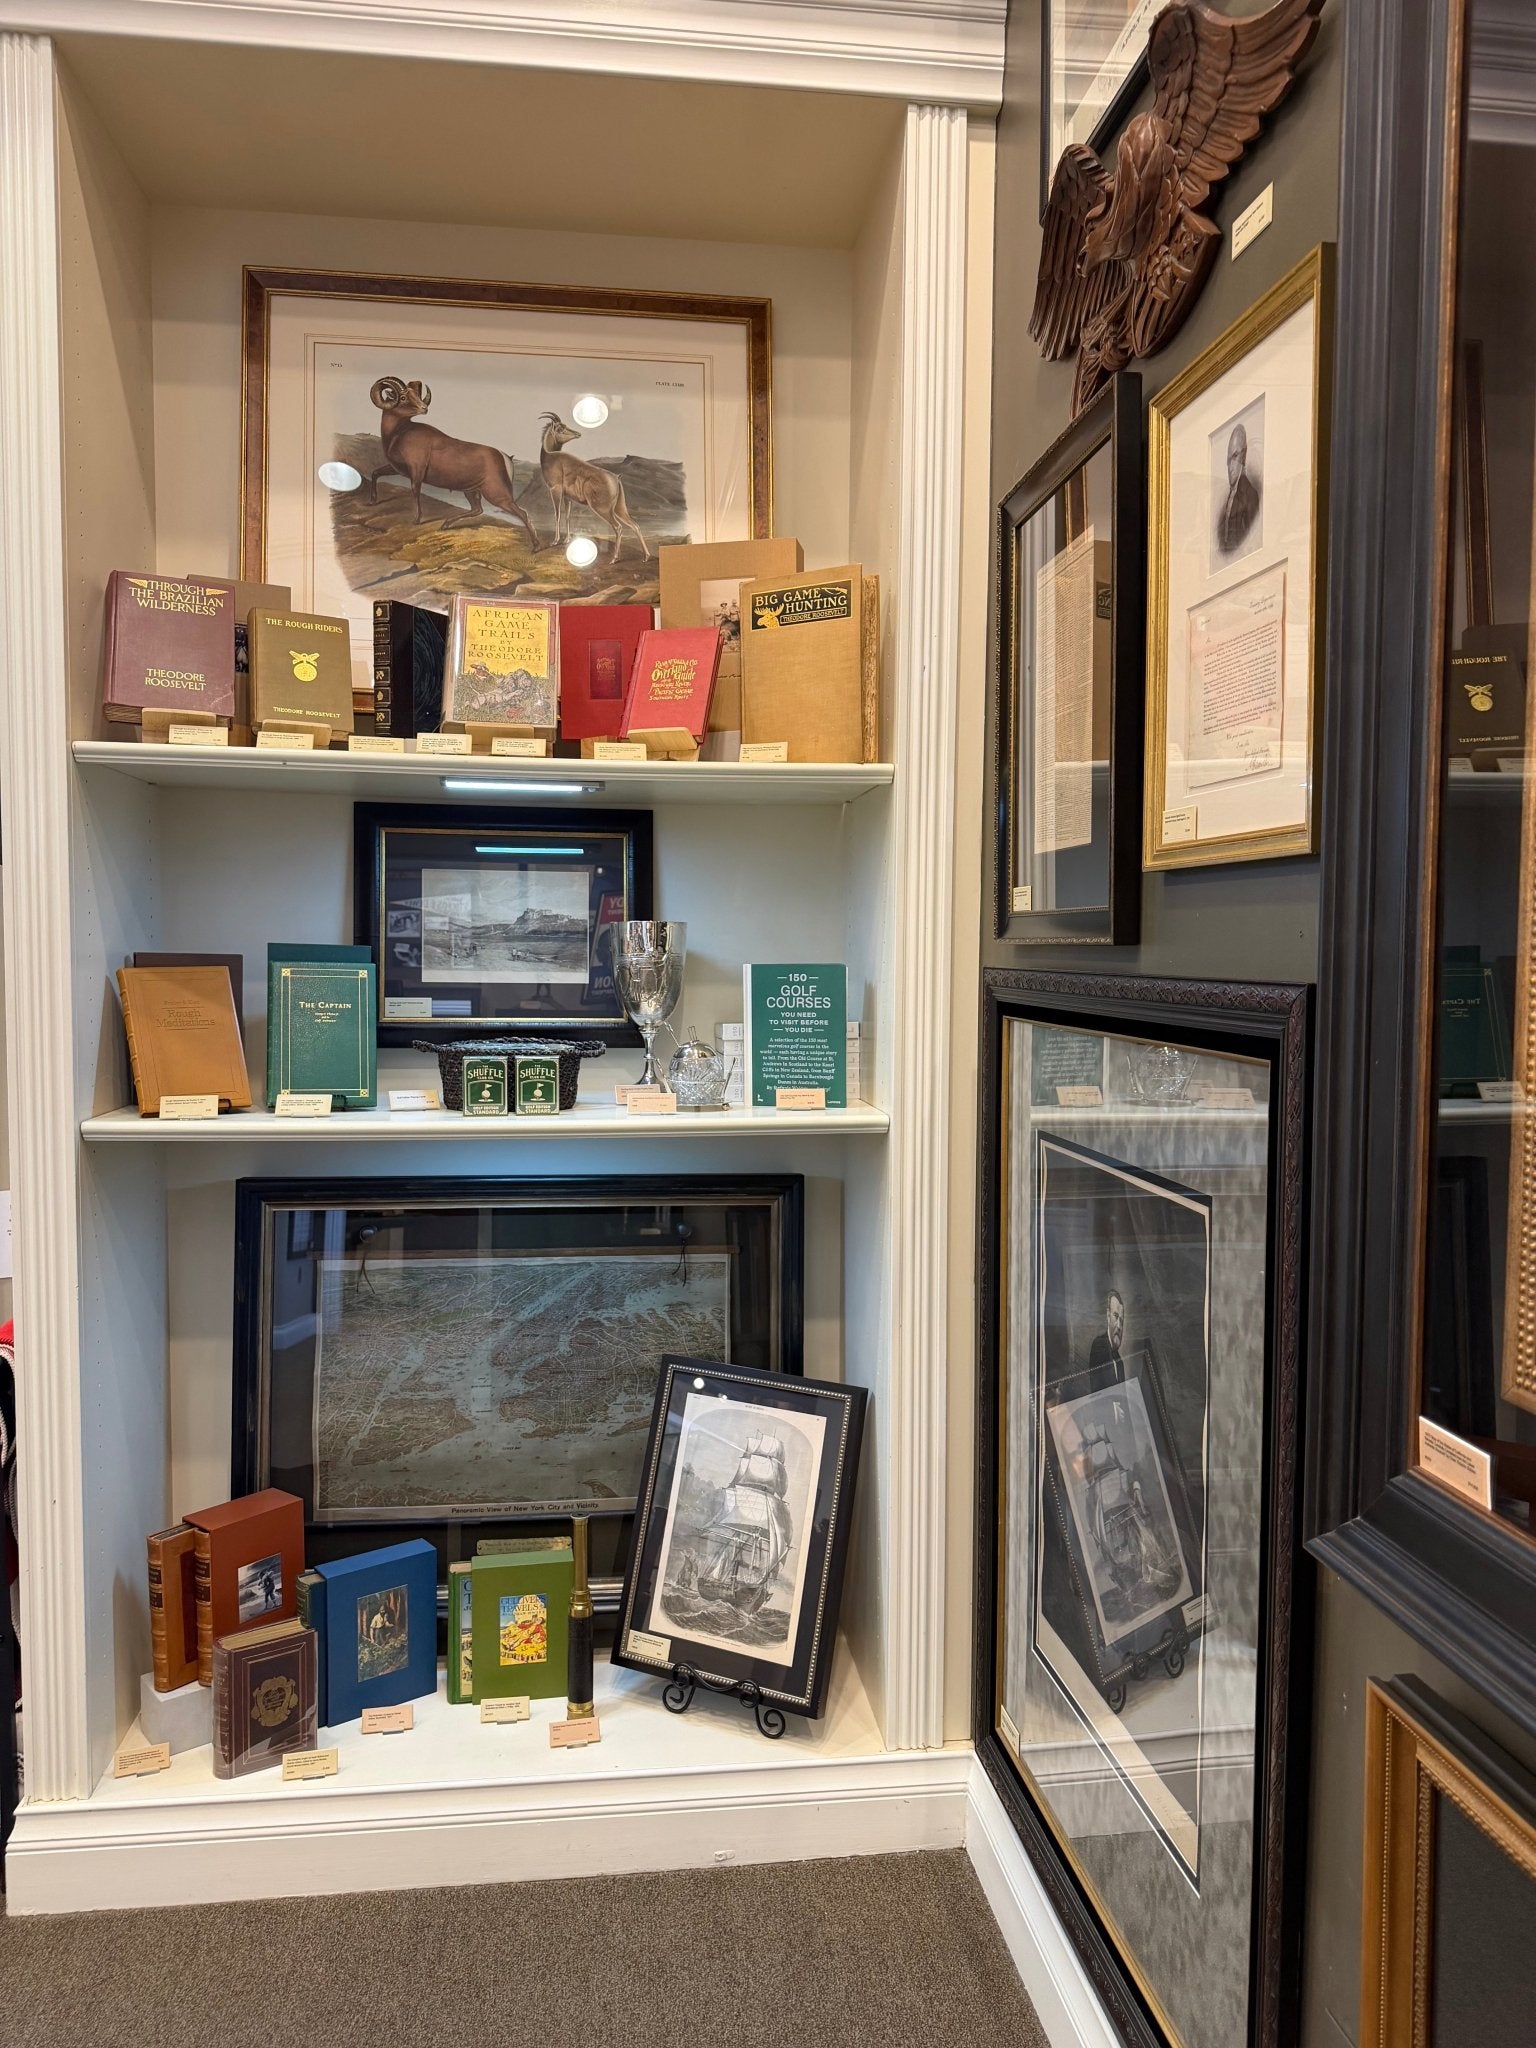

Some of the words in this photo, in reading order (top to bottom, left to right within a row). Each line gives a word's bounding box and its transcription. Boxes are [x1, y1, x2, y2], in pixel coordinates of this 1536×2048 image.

[147, 580, 205, 596] THROUGH
[128, 587, 155, 599] THE
[160, 590, 224, 608] BRAZILIAN
[755, 594, 778, 607] BIG
[783, 588, 822, 603] GAME
[136, 598, 216, 617] WILDERNESS
[785, 595, 848, 614] HUNTING
[472, 609, 543, 621] AFRICAN
[265, 617, 283, 626] THE
[285, 620, 314, 630] ROUGH
[315, 623, 344, 634] RIDERS
[484, 620, 530, 630] GAME
[478, 629, 536, 640] TRAILS
[471, 643, 542, 655] THEODORE
[468, 650, 544, 662] ROOSEVELT
[146, 668, 206, 682] THEODORE
[144, 677, 207, 691] ROOSEVELT
[273, 706, 304, 715] THEODORE
[305, 710, 341, 718] ROOSEVELT
[788, 973, 807, 982] 150
[780, 985, 817, 997] GOLF
[766, 996, 831, 1008] COURSES
[467, 1068, 504, 1079] SHUFFLE
[519, 1067, 556, 1078] SHUFFLE
[502, 1603, 539, 1613] TRAVELS
